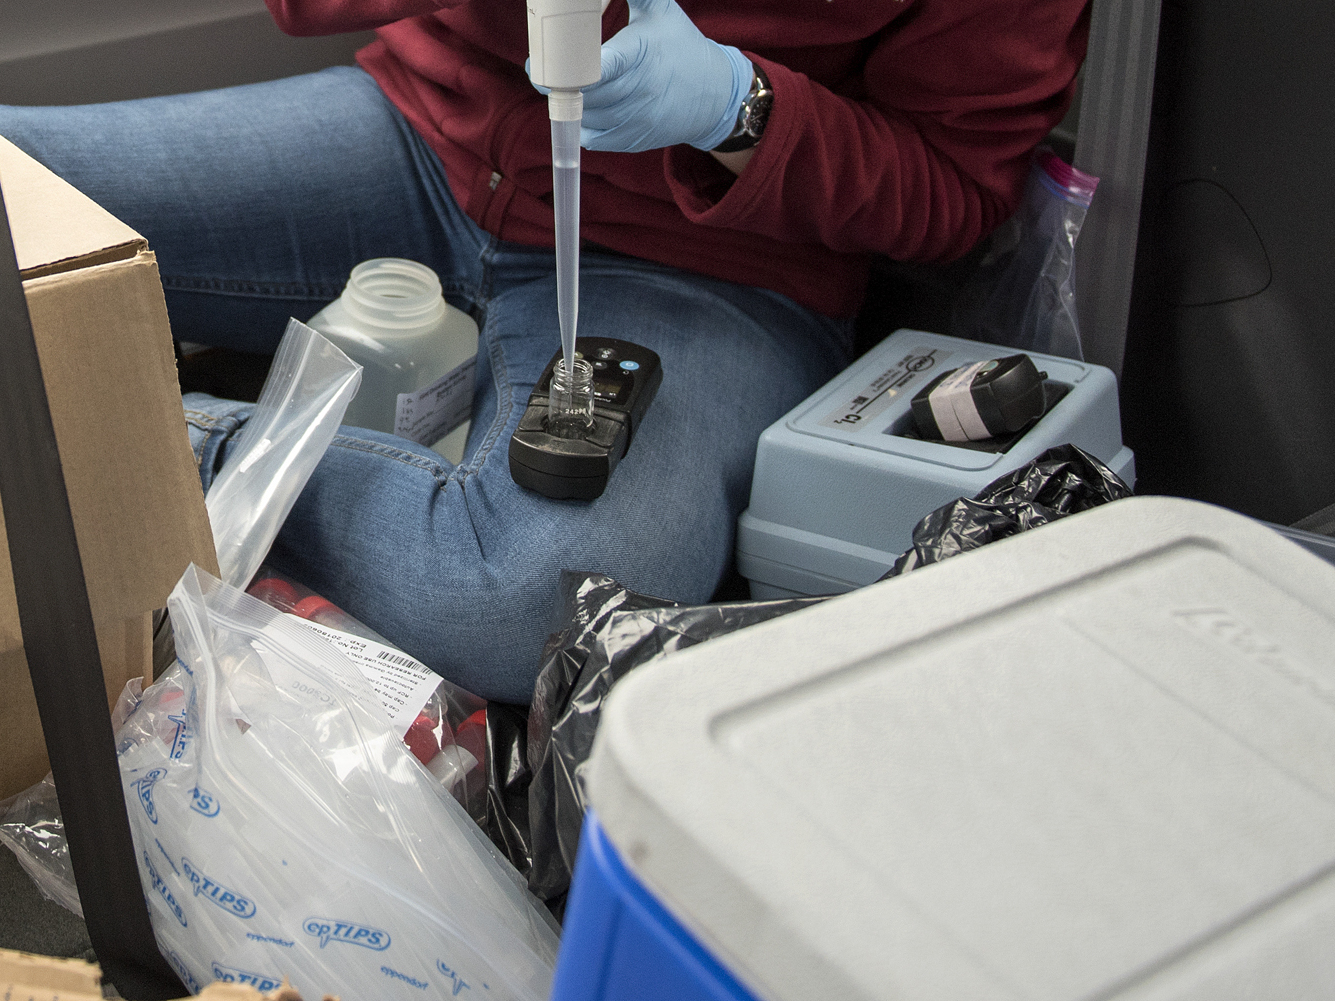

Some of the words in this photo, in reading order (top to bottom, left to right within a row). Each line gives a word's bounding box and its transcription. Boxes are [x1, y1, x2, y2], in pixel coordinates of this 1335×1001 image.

[346, 651, 363, 659] ONLY
[377, 661, 412, 676] RESEARCH
[413, 673, 426, 681] FOR
[183, 862, 249, 913] epTIPS
[246, 932, 295, 948] eppendorf
[307, 922, 384, 945] epTIPS
[380, 965, 429, 990] eppendorf
